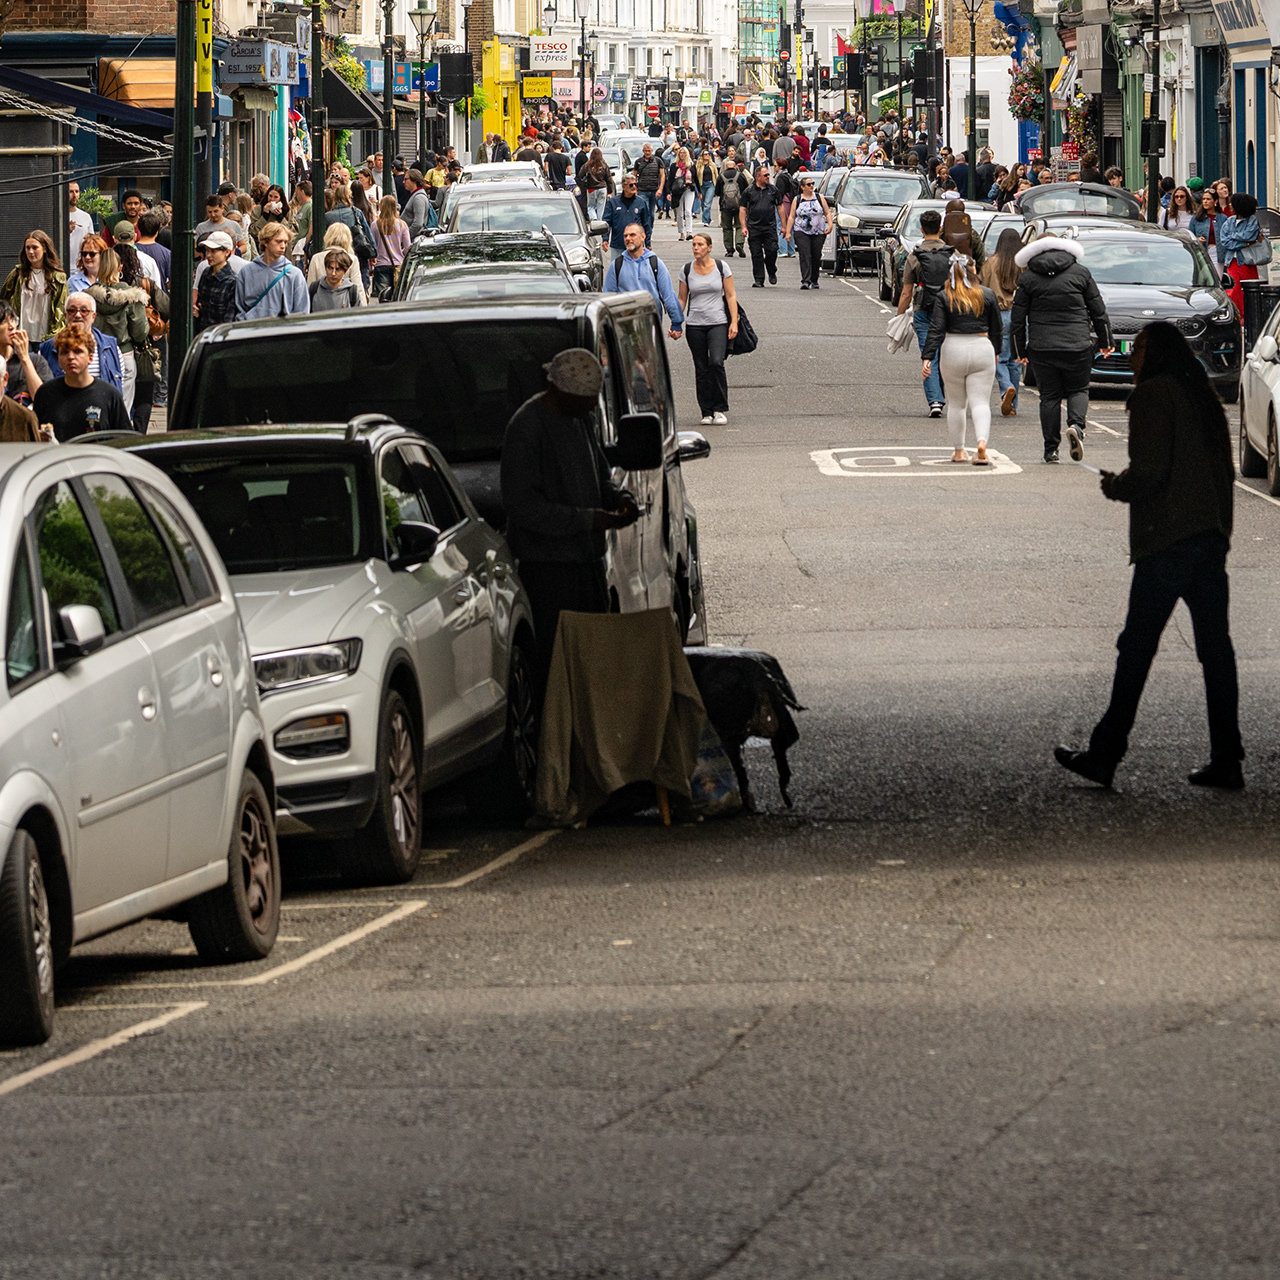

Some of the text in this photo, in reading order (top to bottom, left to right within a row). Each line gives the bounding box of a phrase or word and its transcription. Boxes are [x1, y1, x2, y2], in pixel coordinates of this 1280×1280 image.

[231, 47, 262, 57] GARCIA'S
[534, 54, 568, 63] express
[228, 64, 262, 73] EST. 1957
